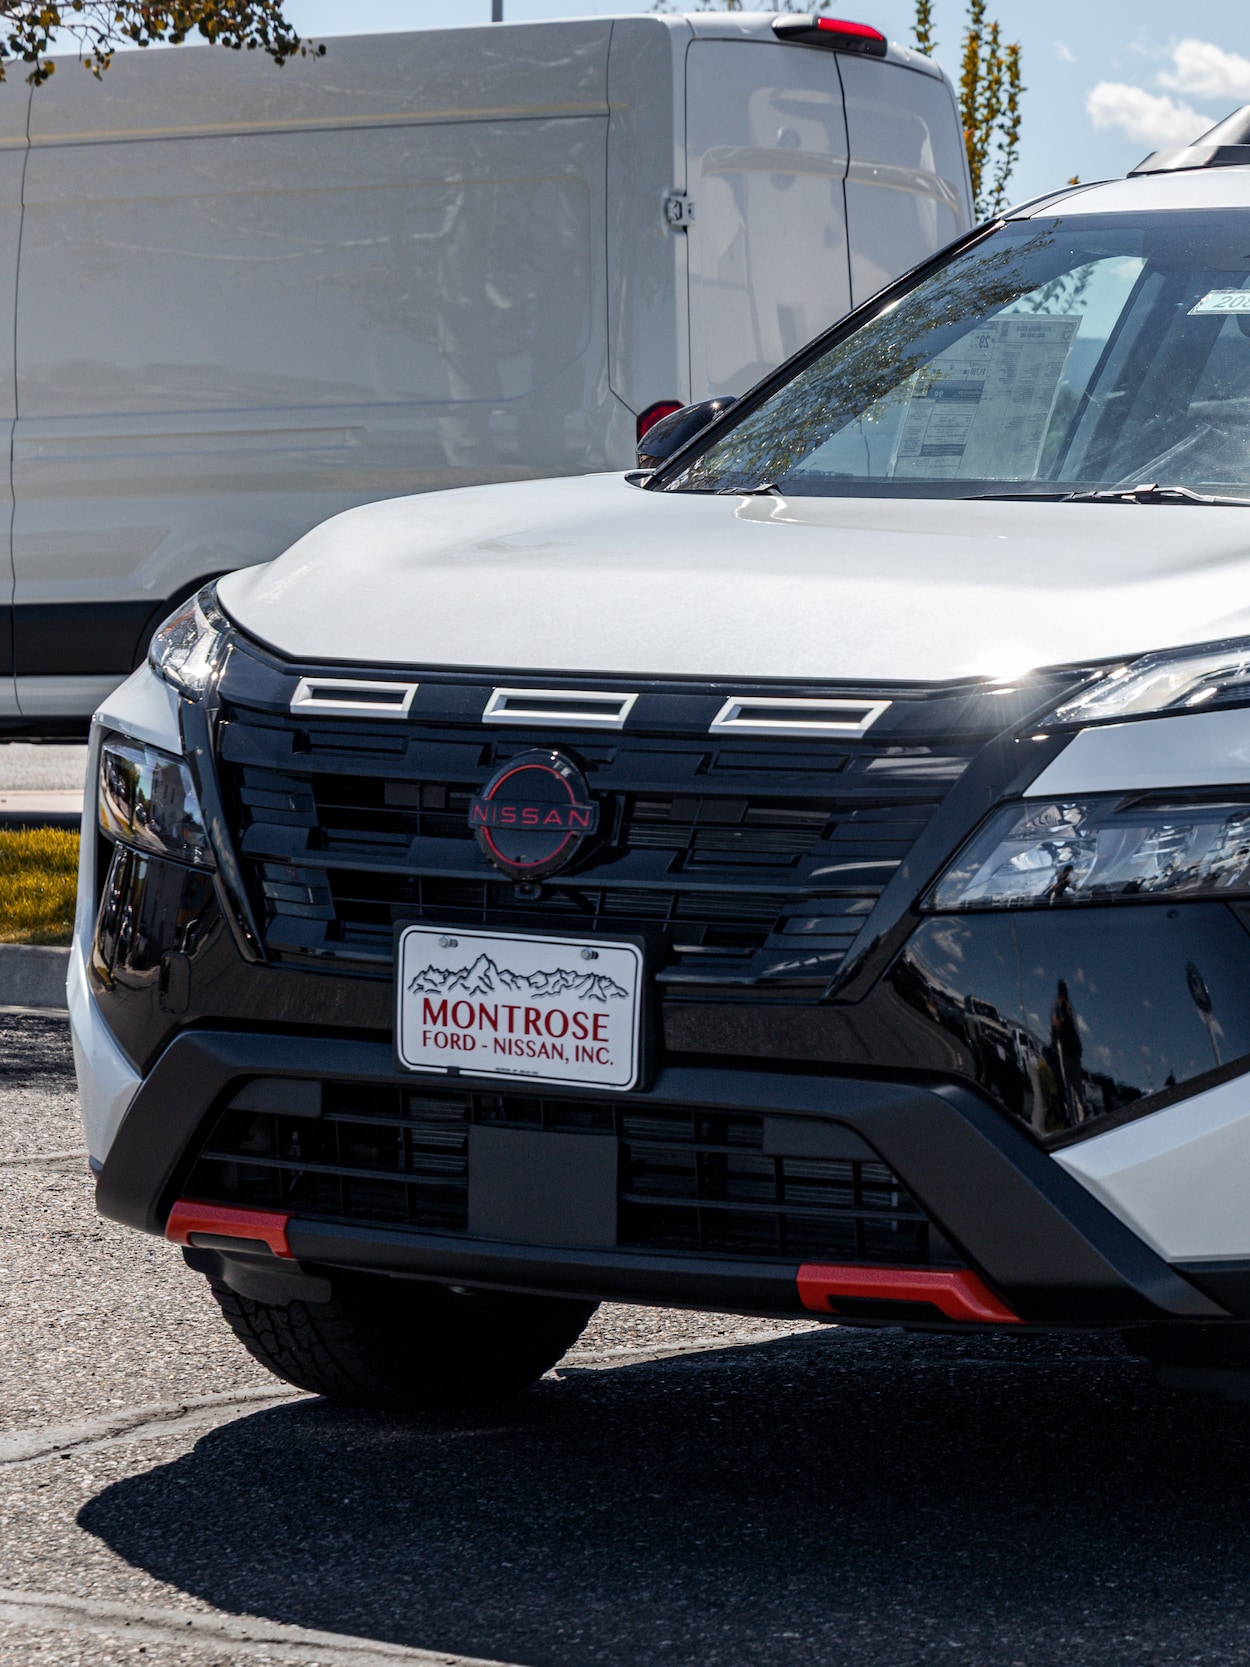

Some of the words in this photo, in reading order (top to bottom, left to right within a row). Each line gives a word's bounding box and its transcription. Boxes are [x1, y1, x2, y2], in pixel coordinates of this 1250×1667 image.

[471, 804, 591, 827] NISSAN
[422, 997, 610, 1042] MONTROSE
[422, 1030, 476, 1051] FORD
[493, 1037, 570, 1064] NISSAN,
[574, 1044, 614, 1066] INC.
